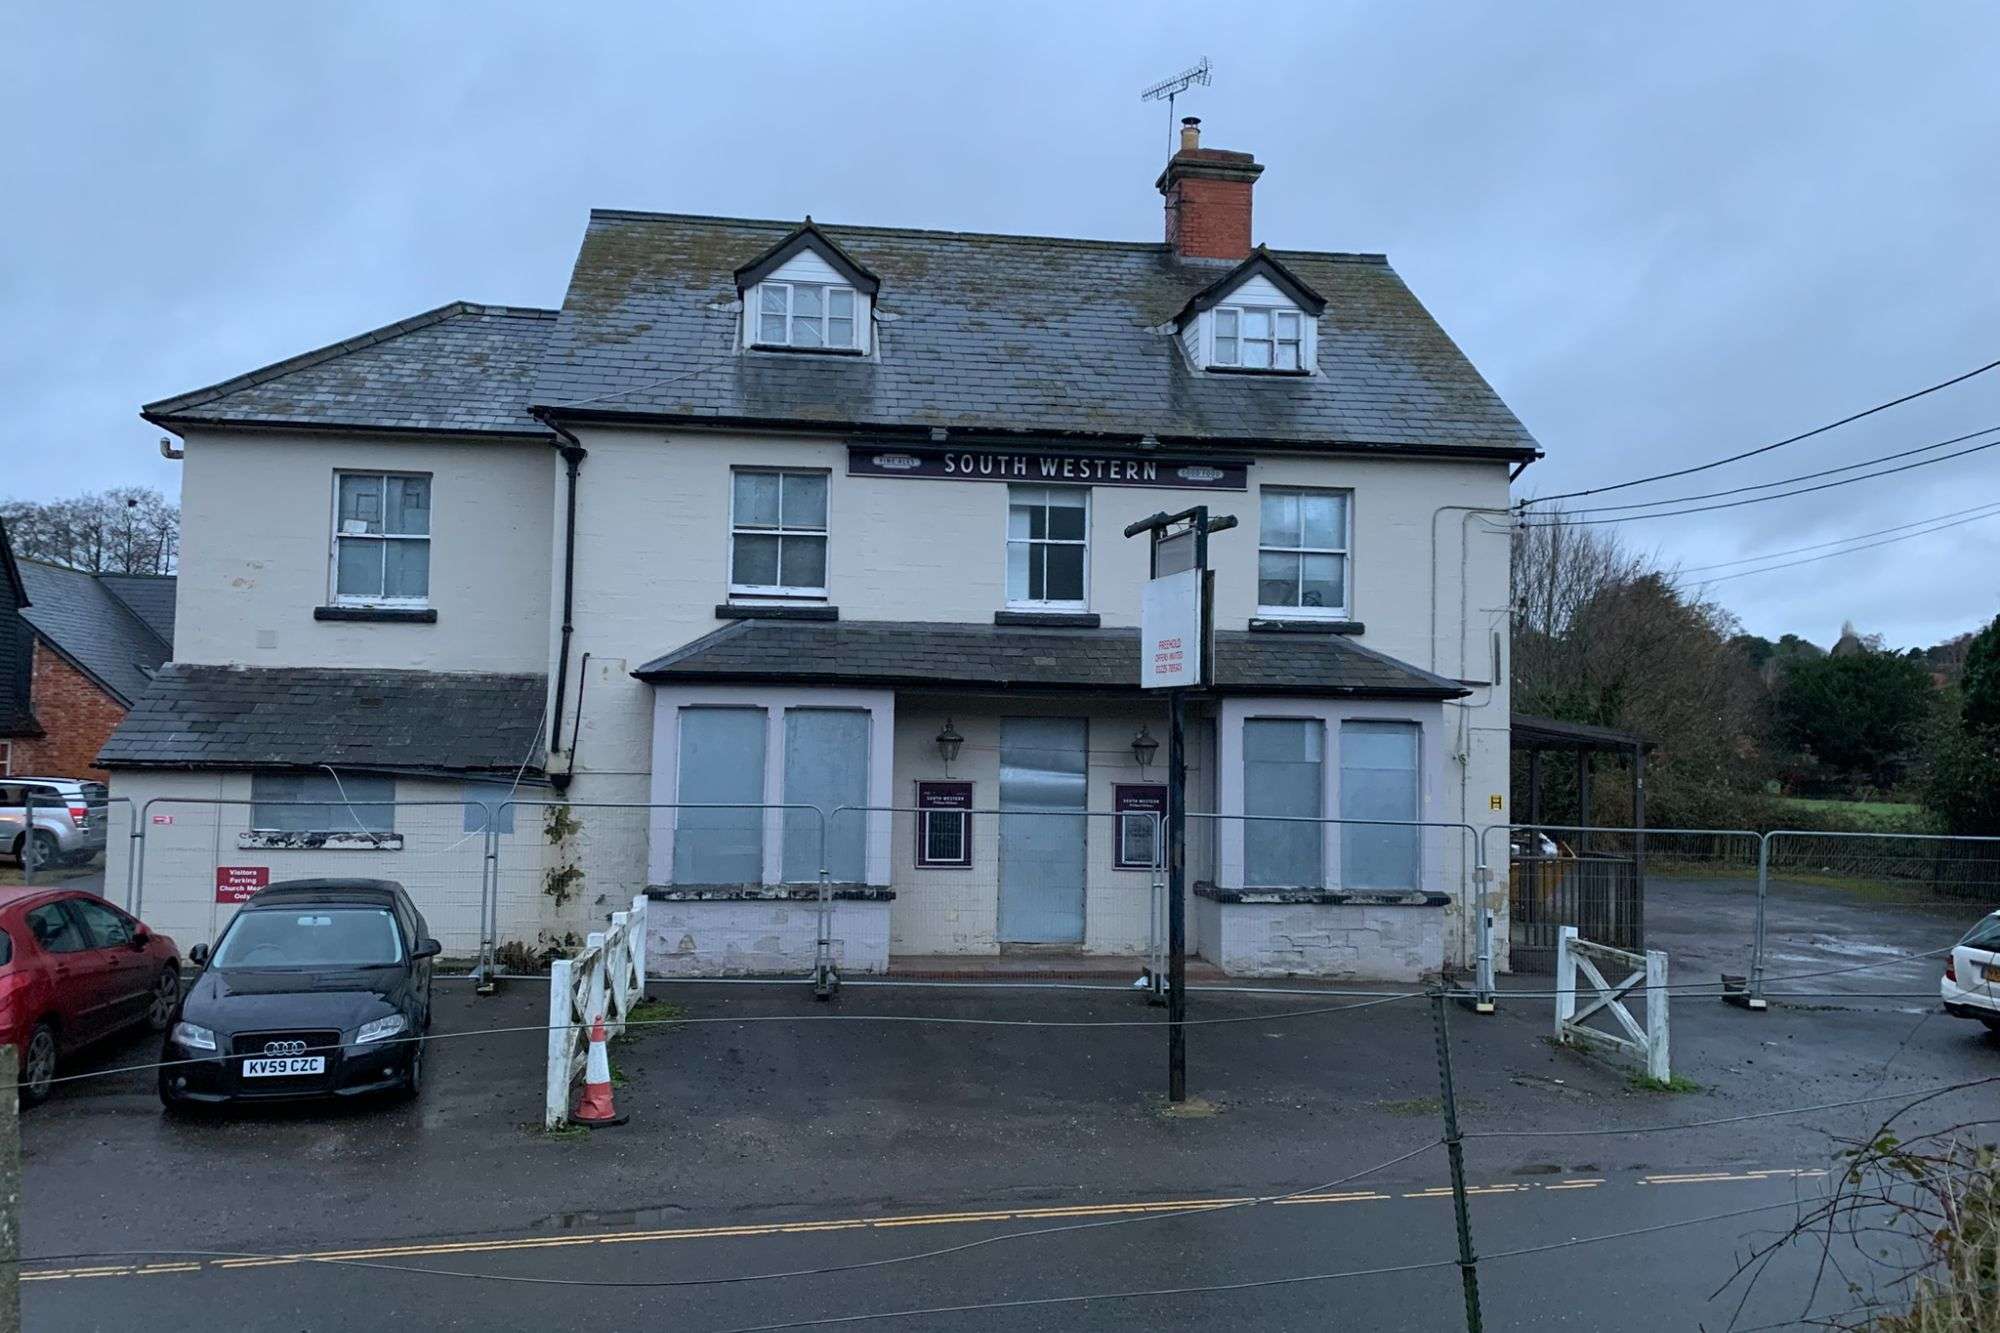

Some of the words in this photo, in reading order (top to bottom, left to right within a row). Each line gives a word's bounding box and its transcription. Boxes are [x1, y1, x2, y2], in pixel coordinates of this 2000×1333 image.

[944, 453, 1026, 475] SOUTH
[1040, 457, 1156, 480] WESTERN
[249, 1060, 287, 1074] KV59
[290, 1058, 318, 1072] CZC
